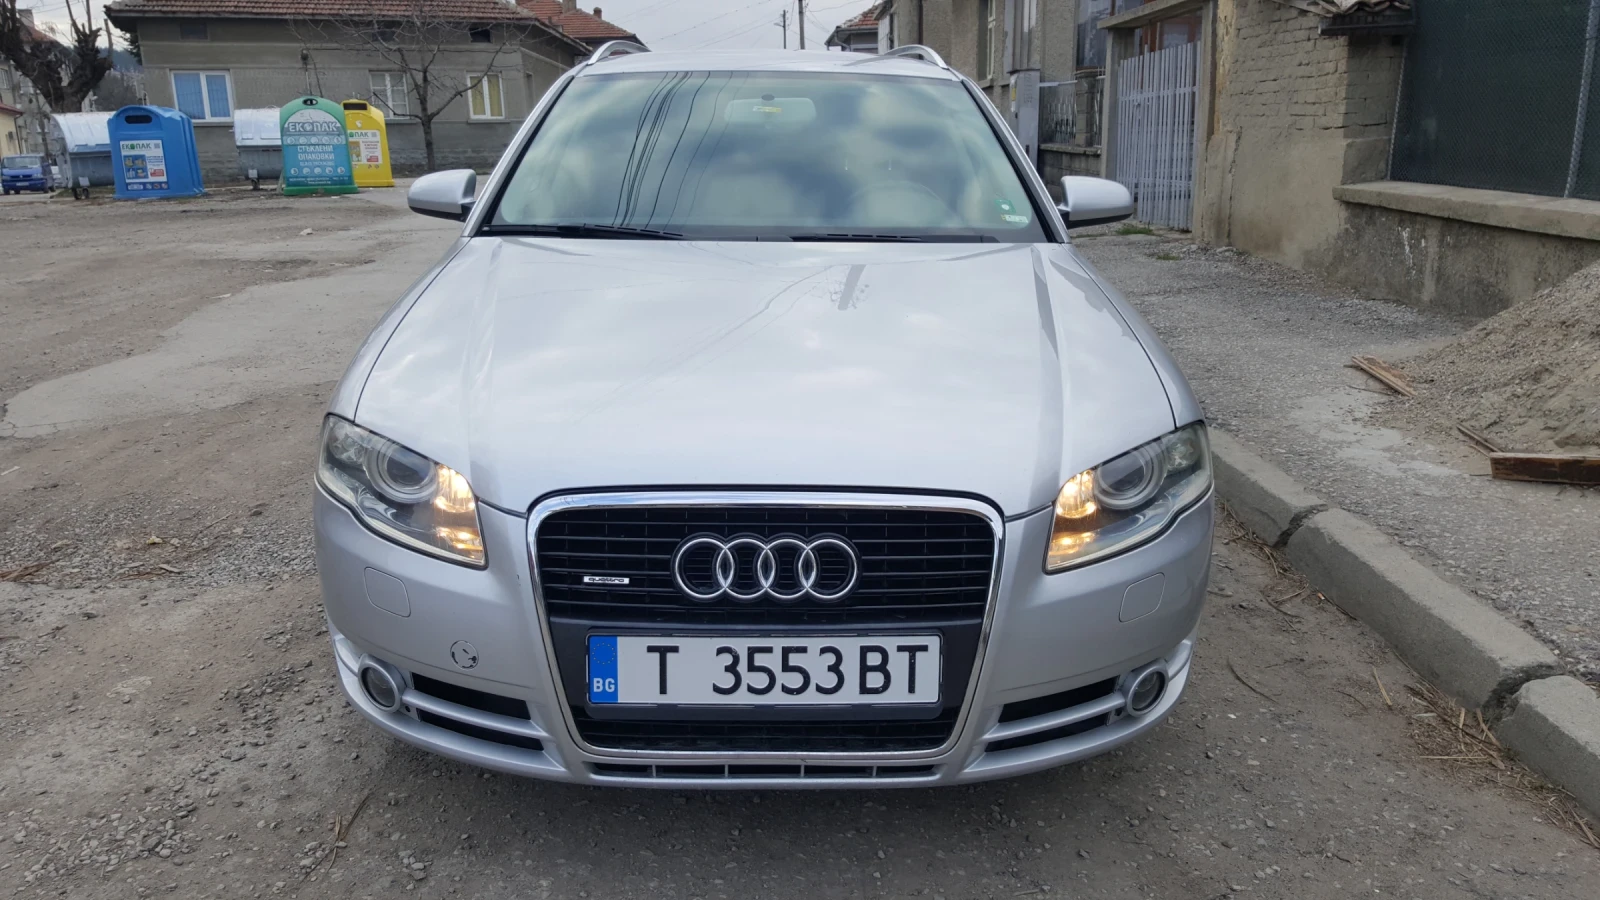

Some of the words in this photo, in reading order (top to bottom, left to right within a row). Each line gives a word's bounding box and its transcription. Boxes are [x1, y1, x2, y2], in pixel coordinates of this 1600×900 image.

[289, 122, 338, 132] ЕКОПАК
[121, 142, 152, 150] ЕКОПАК
[646, 645, 680, 695] T
[712, 645, 845, 695] 3553
[858, 644, 929, 694] BT
[593, 678, 616, 692] BG
